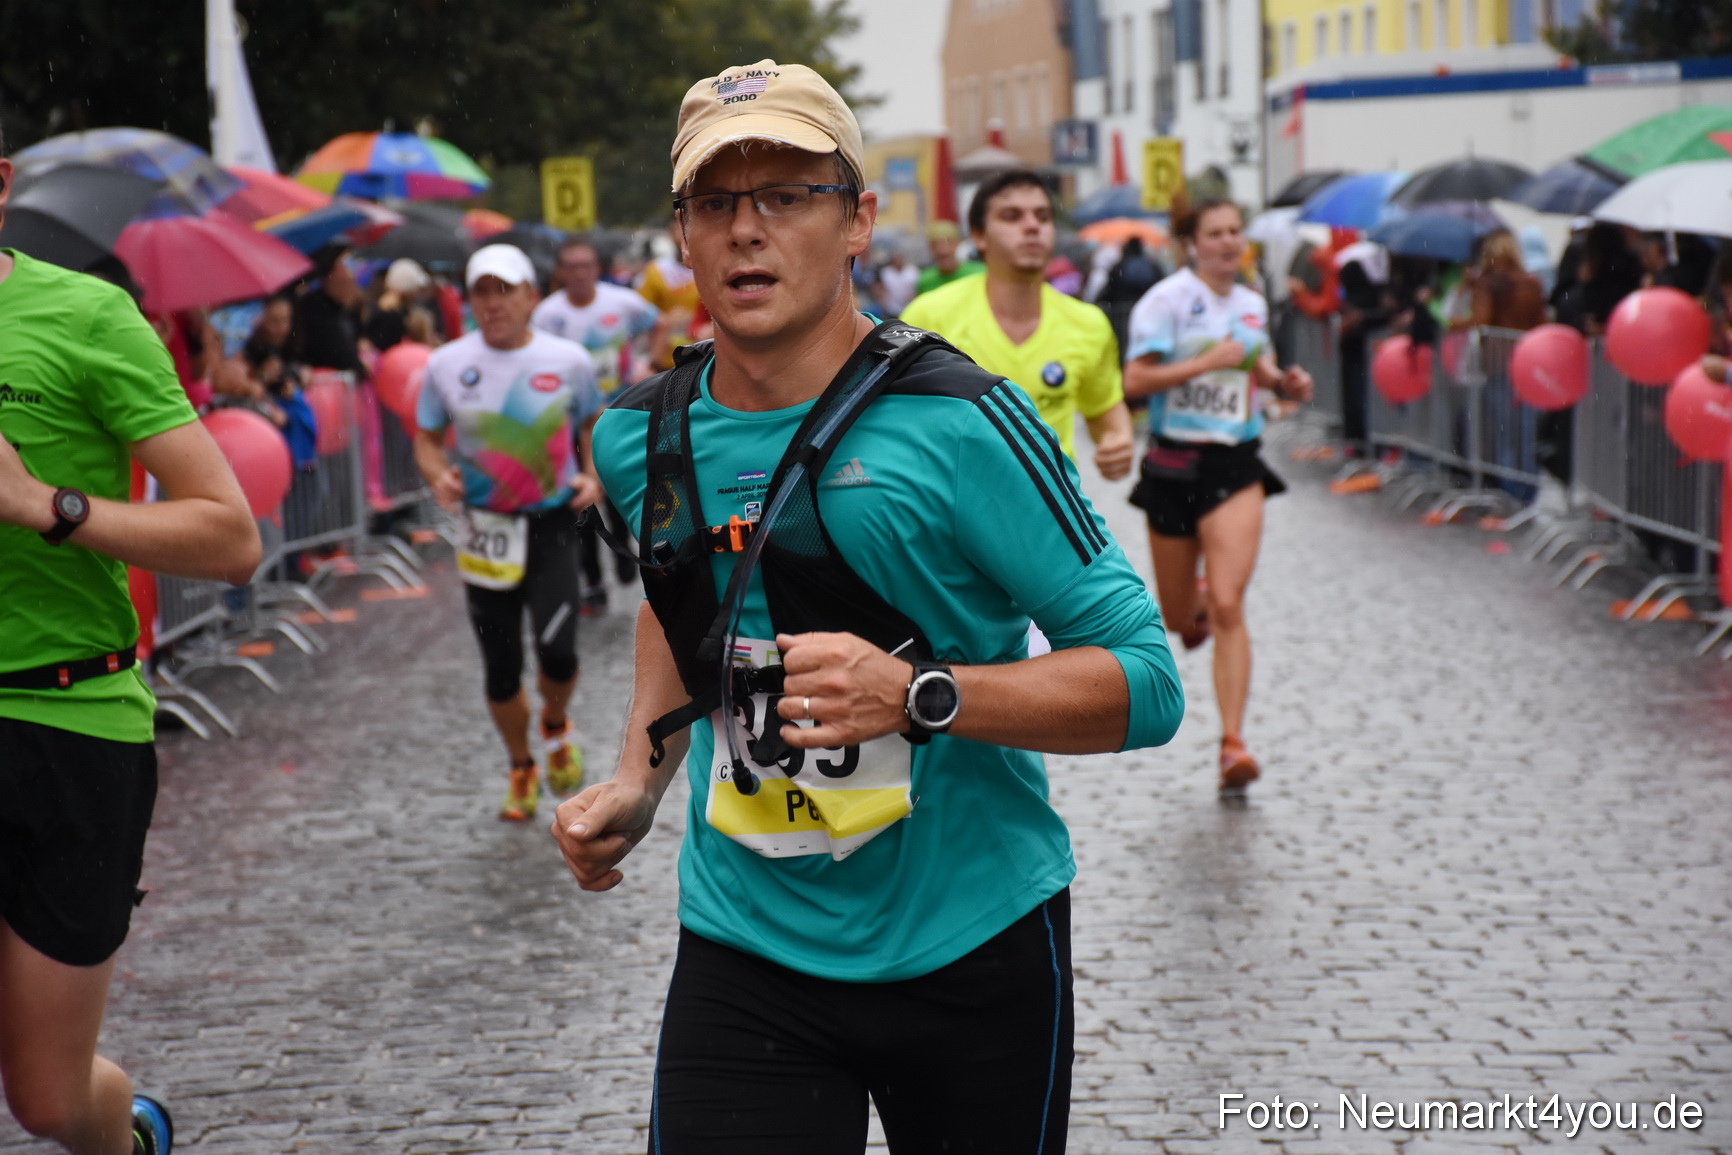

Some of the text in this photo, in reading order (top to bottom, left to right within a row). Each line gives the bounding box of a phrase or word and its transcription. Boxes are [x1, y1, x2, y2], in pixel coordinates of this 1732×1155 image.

[745, 70, 780, 79] NAVY
[723, 94, 757, 105] 2000
[556, 180, 582, 216] D
[826, 475, 872, 486] adidas
[717, 486, 739, 495] PRAGUE
[740, 484, 756, 492] HALF
